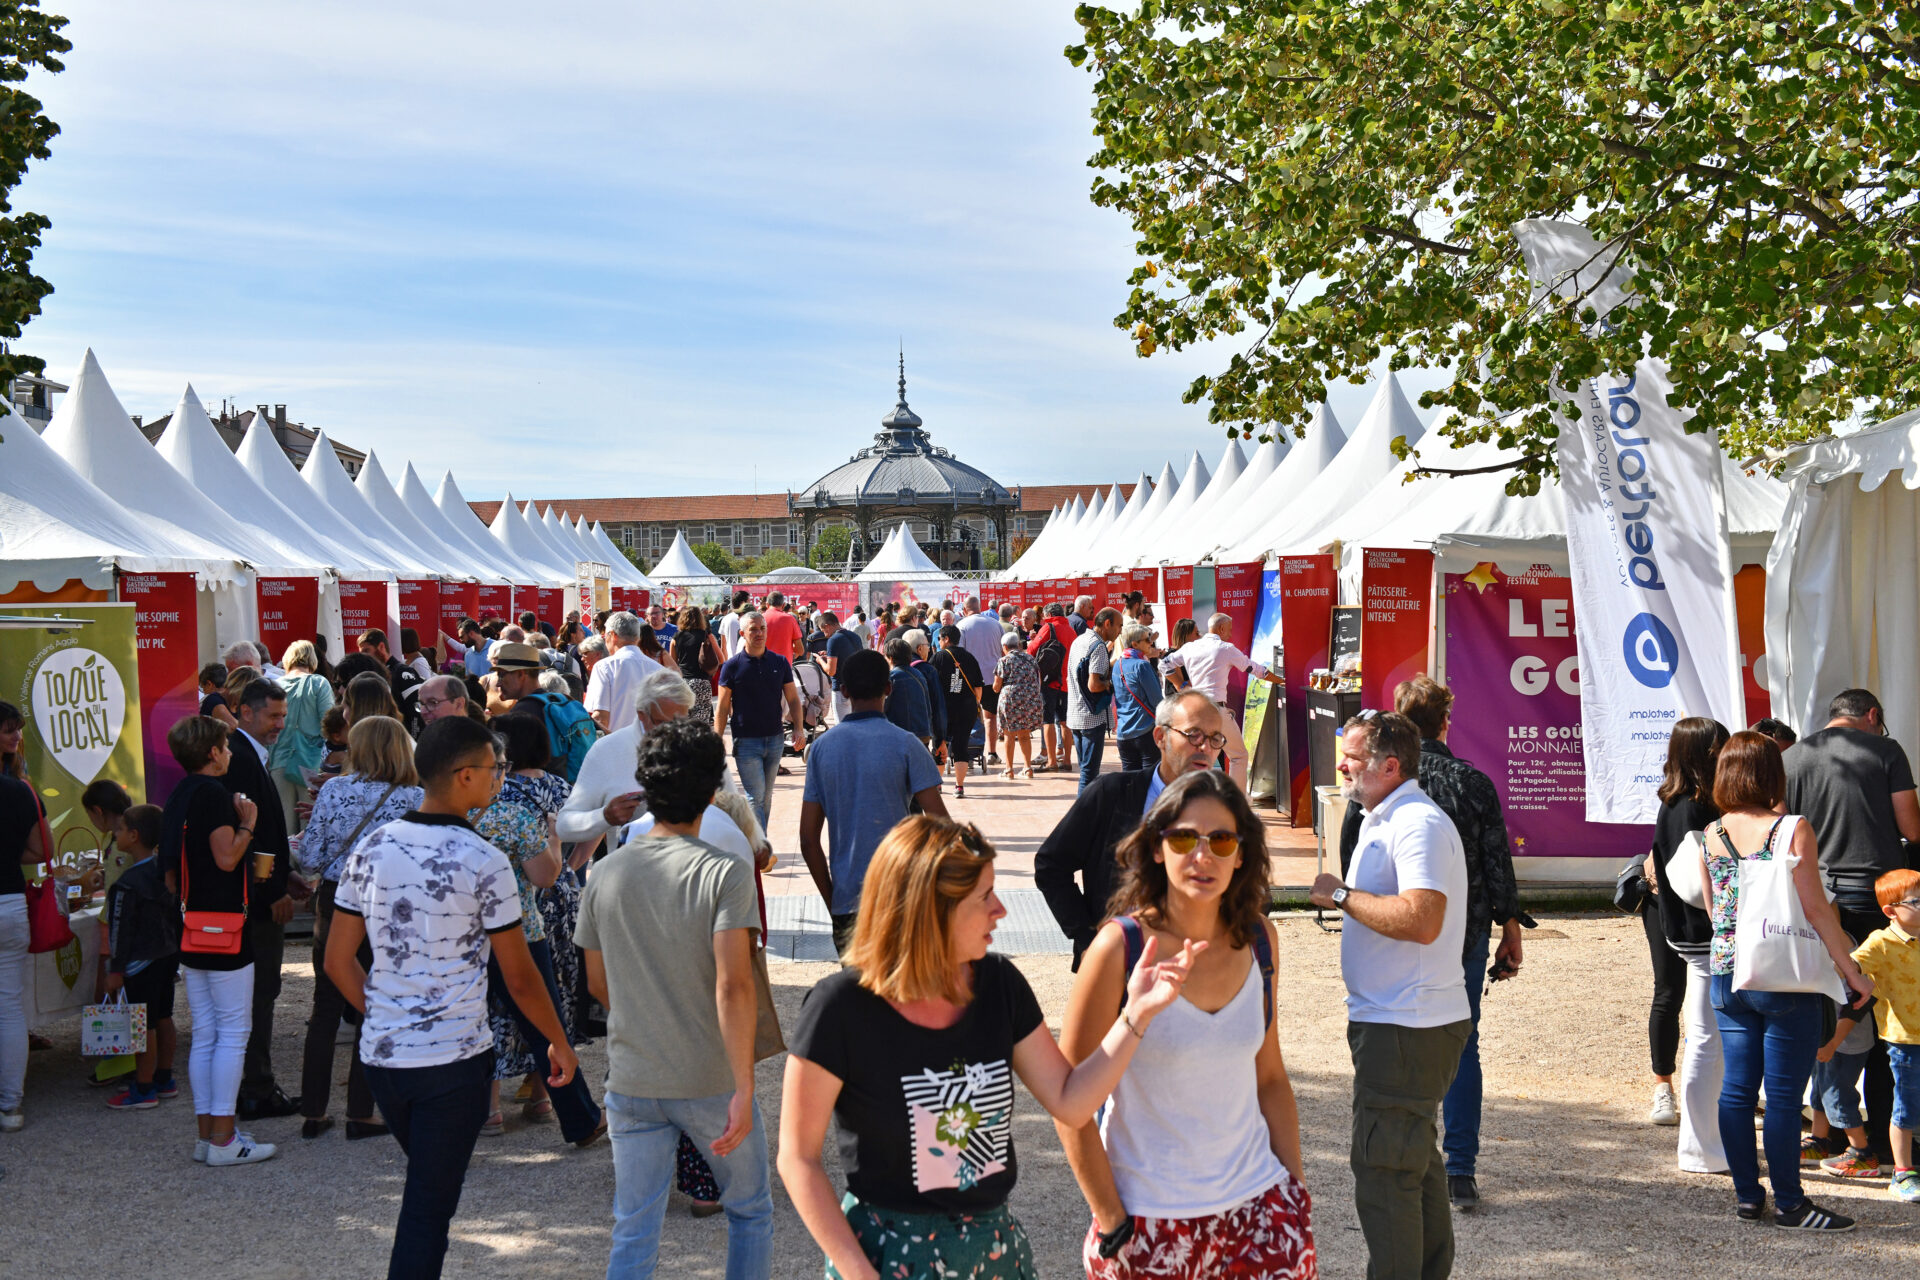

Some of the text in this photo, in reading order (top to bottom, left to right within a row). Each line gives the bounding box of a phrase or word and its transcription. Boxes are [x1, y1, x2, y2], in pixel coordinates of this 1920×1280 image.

[1507, 577, 1540, 585] FESTIVAL
[1232, 588, 1253, 597] DÉLICES
[1285, 589, 1293, 597] M.
[1294, 588, 1330, 597] CHAPOUTIER
[1368, 584, 1407, 597] PÂTISSERIE
[1231, 599, 1245, 607] JULIE
[1368, 599, 1420, 610] CHOCOLATERIE
[136, 611, 180, 622] NE-SOPHIE
[263, 611, 283, 620] ALAIN
[1368, 612, 1396, 622] INTENSE
[1508, 598, 1576, 638] LE
[263, 621, 288, 631] MILLIAT
[152, 638, 166, 649] PIC
[20, 668, 33, 702] Valence
[28, 643, 55, 668] Romans
[55, 637, 79, 648] Agglo
[49, 707, 114, 754] LOCAL
[1508, 726, 1539, 739] LES
[1508, 741, 1582, 753] MONNAIE
[1531, 759, 1547, 767] 12€,
[1518, 768, 1544, 776] tickets,
[1523, 777, 1558, 785] Pagodes.
[1547, 795, 1567, 803] place
